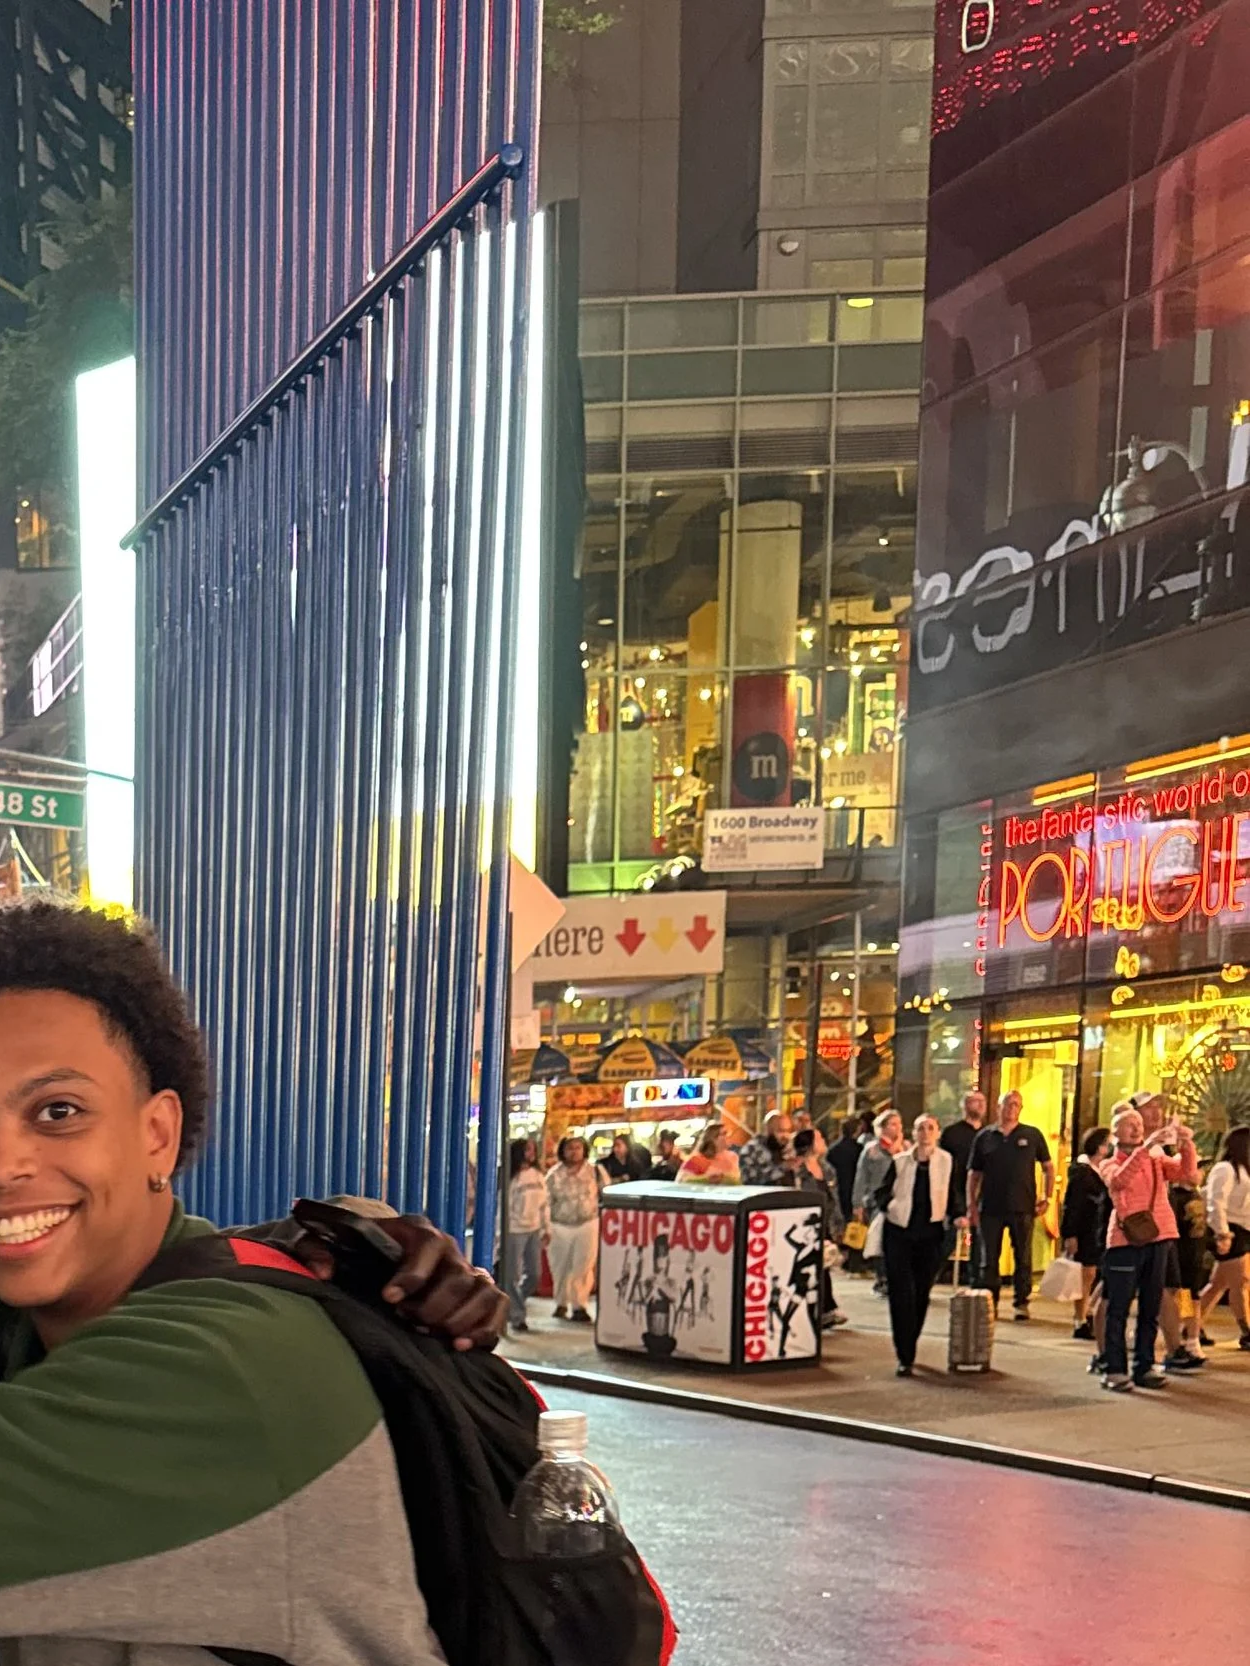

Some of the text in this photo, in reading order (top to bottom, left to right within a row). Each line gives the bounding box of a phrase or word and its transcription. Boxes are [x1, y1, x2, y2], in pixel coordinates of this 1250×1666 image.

[30, 795, 58, 819] St
[1153, 767, 1226, 817] world
[1232, 770, 1250, 798] o
[713, 815, 818, 830] 1600 Broadway
[602, 1208, 734, 1254] CHICAGO
[745, 1209, 770, 1362] CHICAGO
